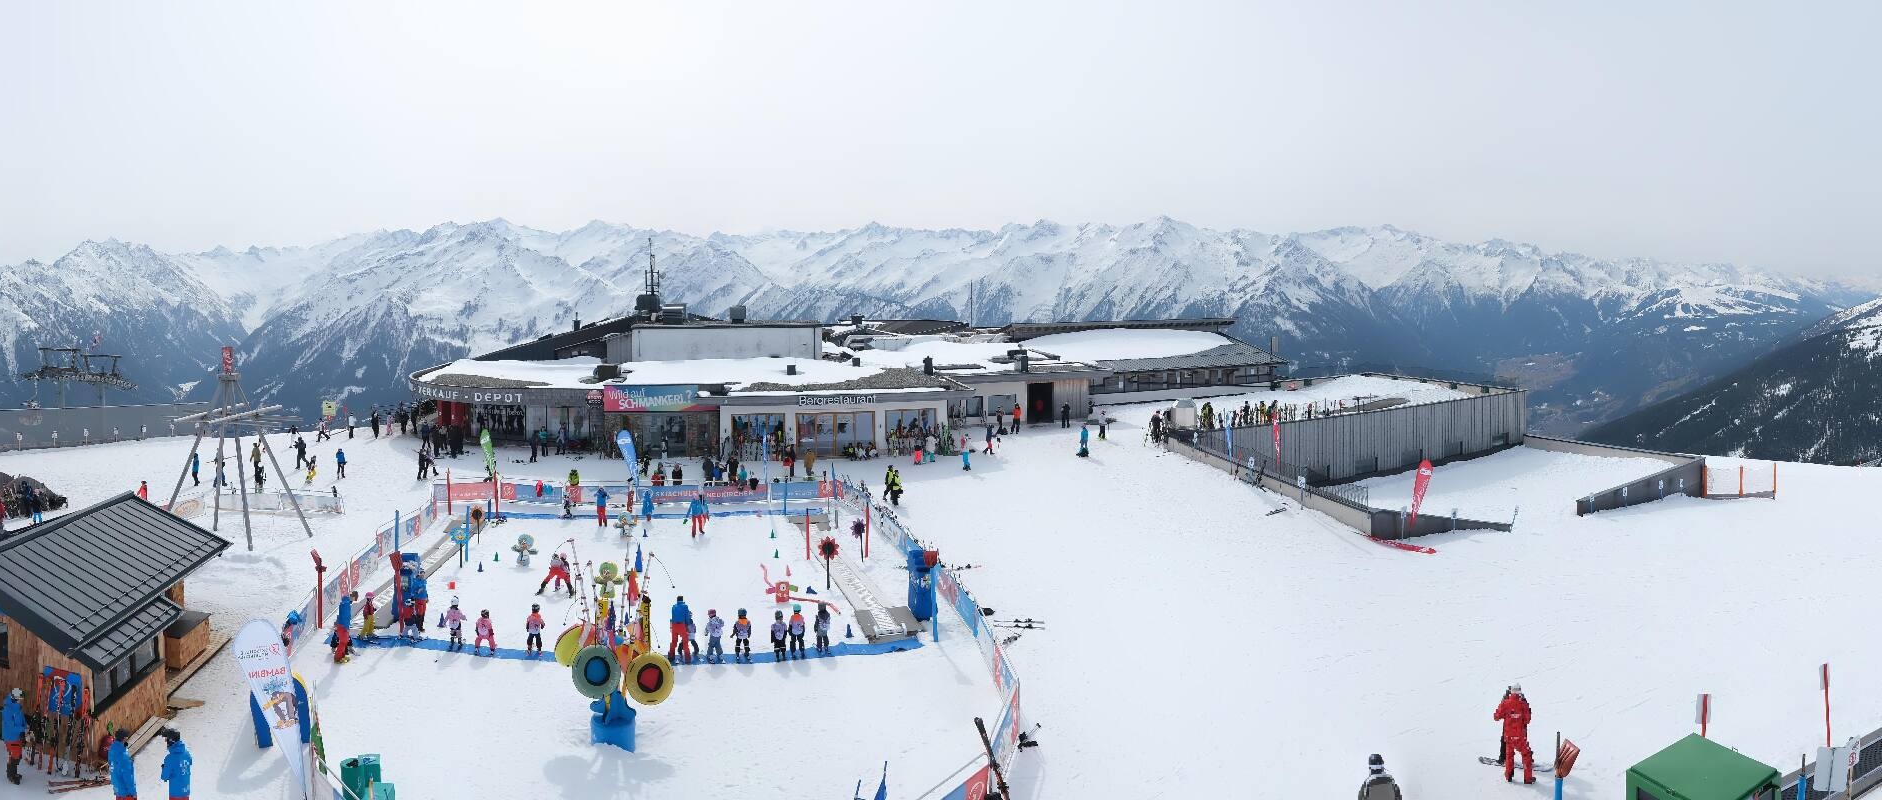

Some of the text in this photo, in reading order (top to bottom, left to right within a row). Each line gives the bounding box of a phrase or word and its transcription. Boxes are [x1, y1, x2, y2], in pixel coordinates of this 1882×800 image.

[474, 392, 523, 403] DEPOT
[609, 389, 629, 400] Wild
[631, 388, 645, 398] auf
[798, 395, 877, 406] Bergrestaurant
